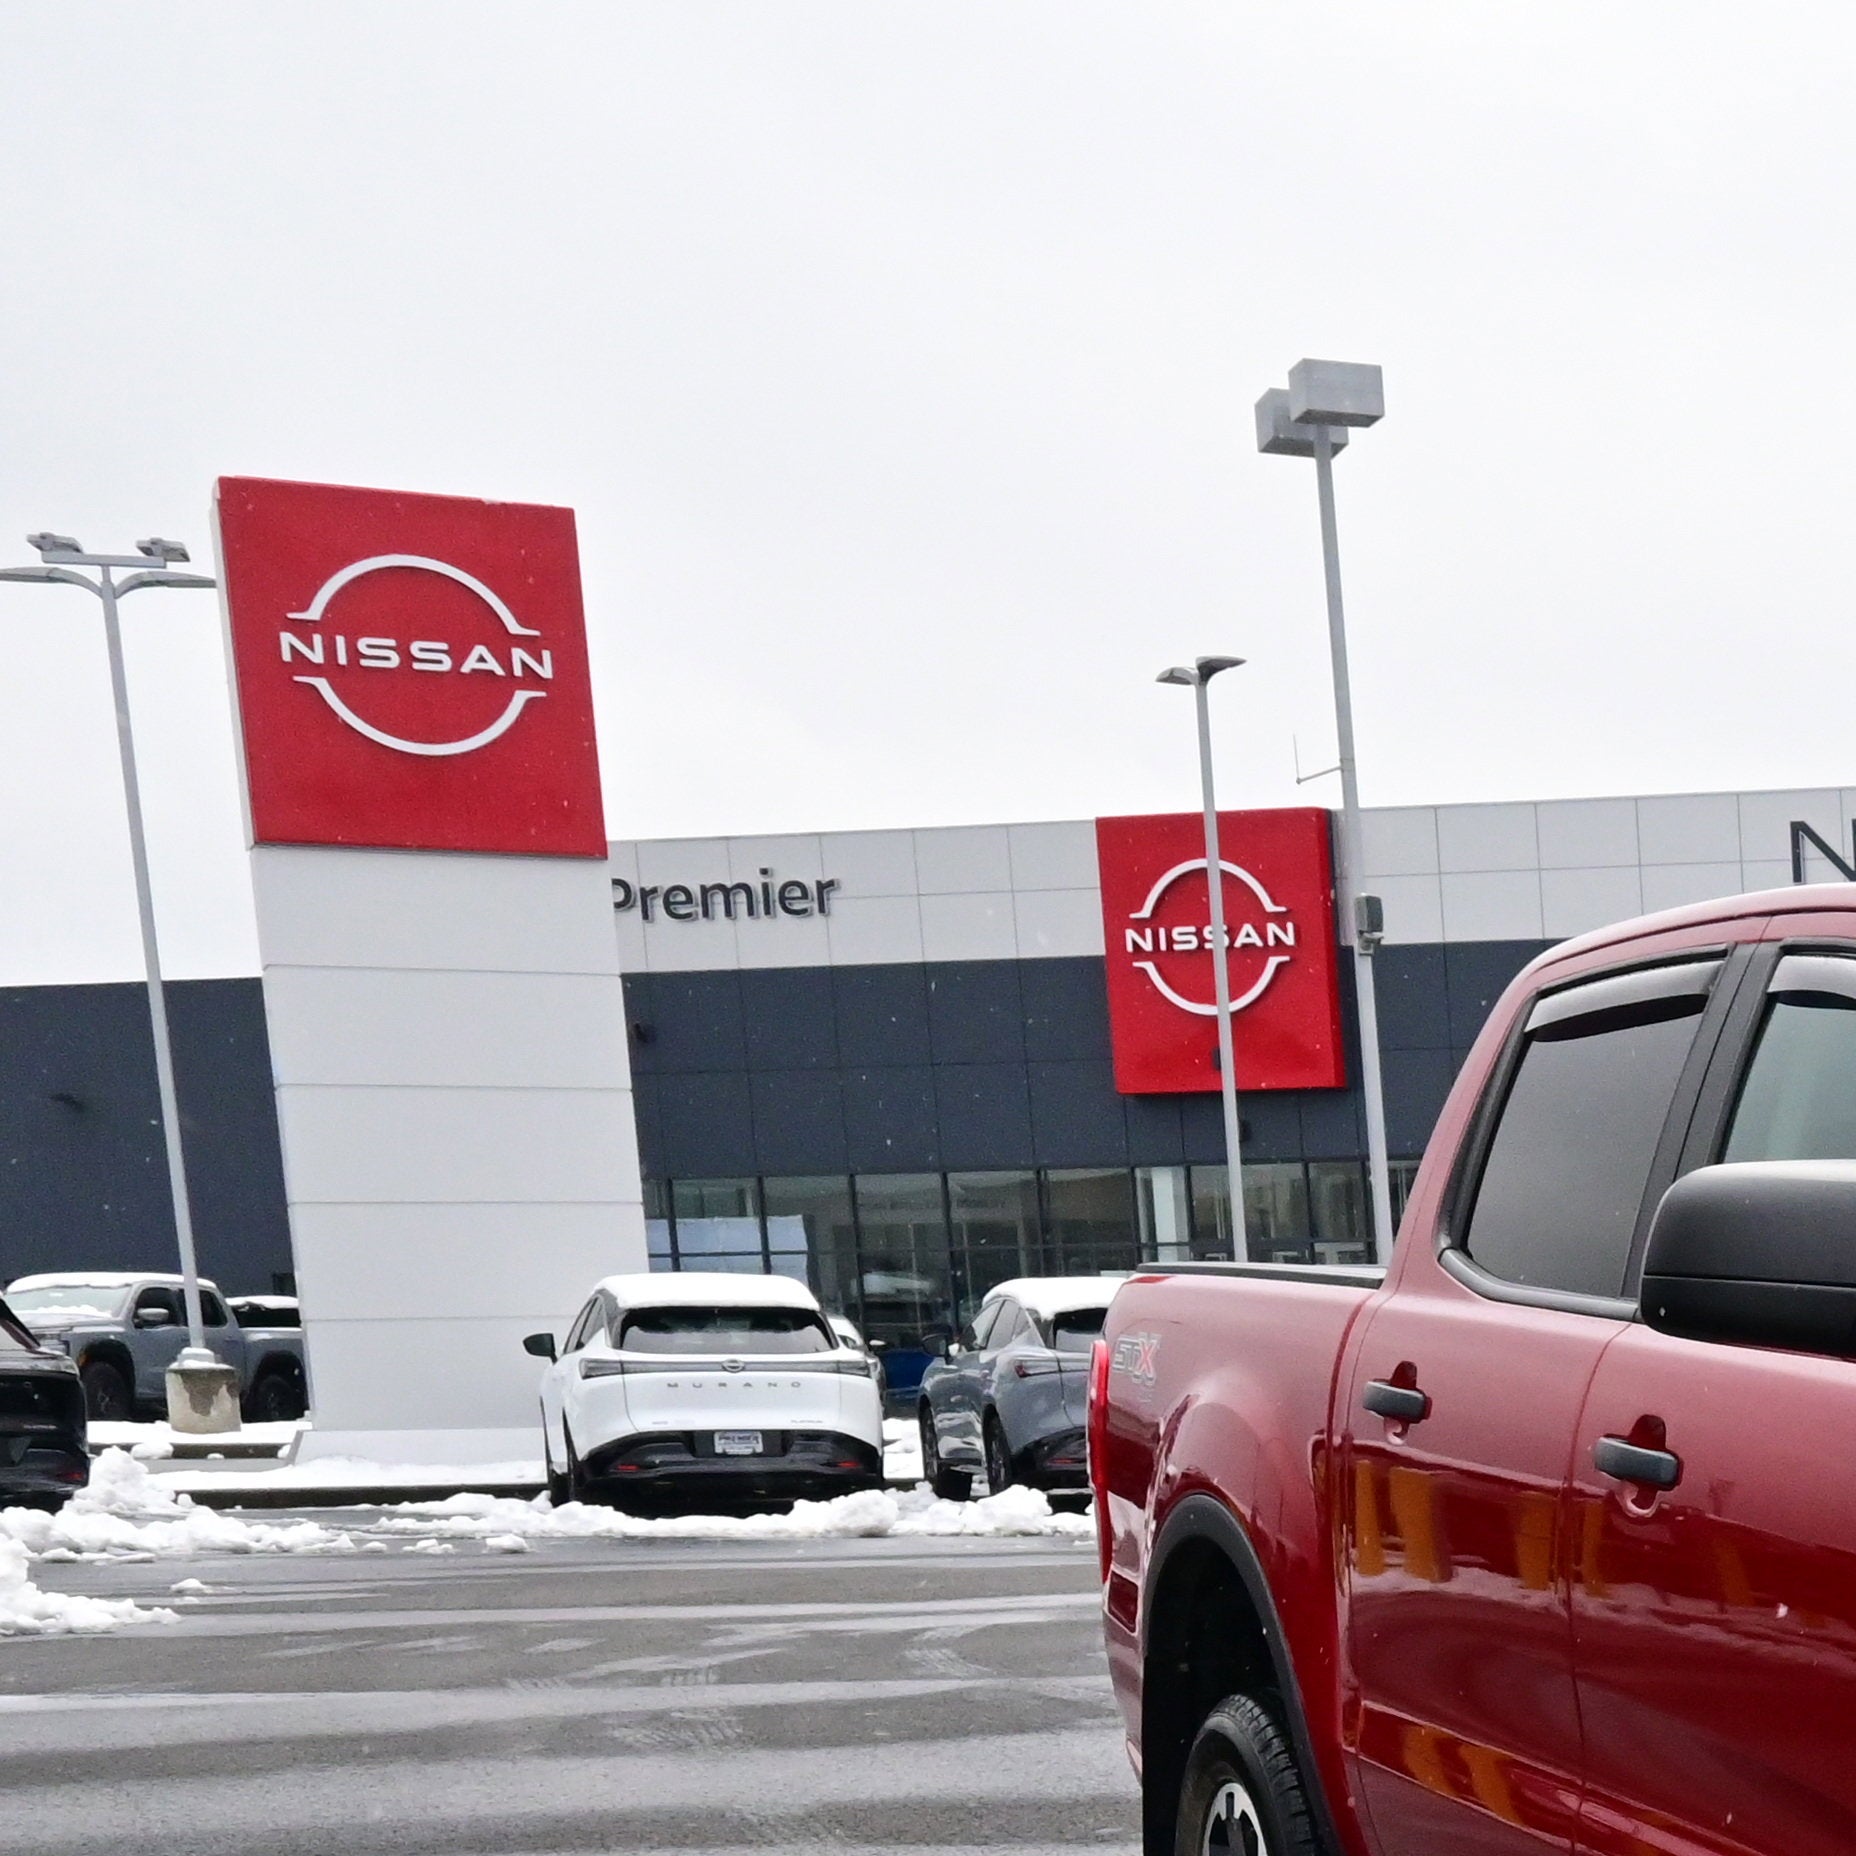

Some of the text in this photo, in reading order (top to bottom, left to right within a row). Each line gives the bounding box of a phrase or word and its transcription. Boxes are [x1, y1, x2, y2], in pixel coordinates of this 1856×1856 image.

[279, 631, 553, 679] NISSAN
[1125, 922, 1295, 952] NISSAN
[1113, 1333, 1161, 1385] STX
